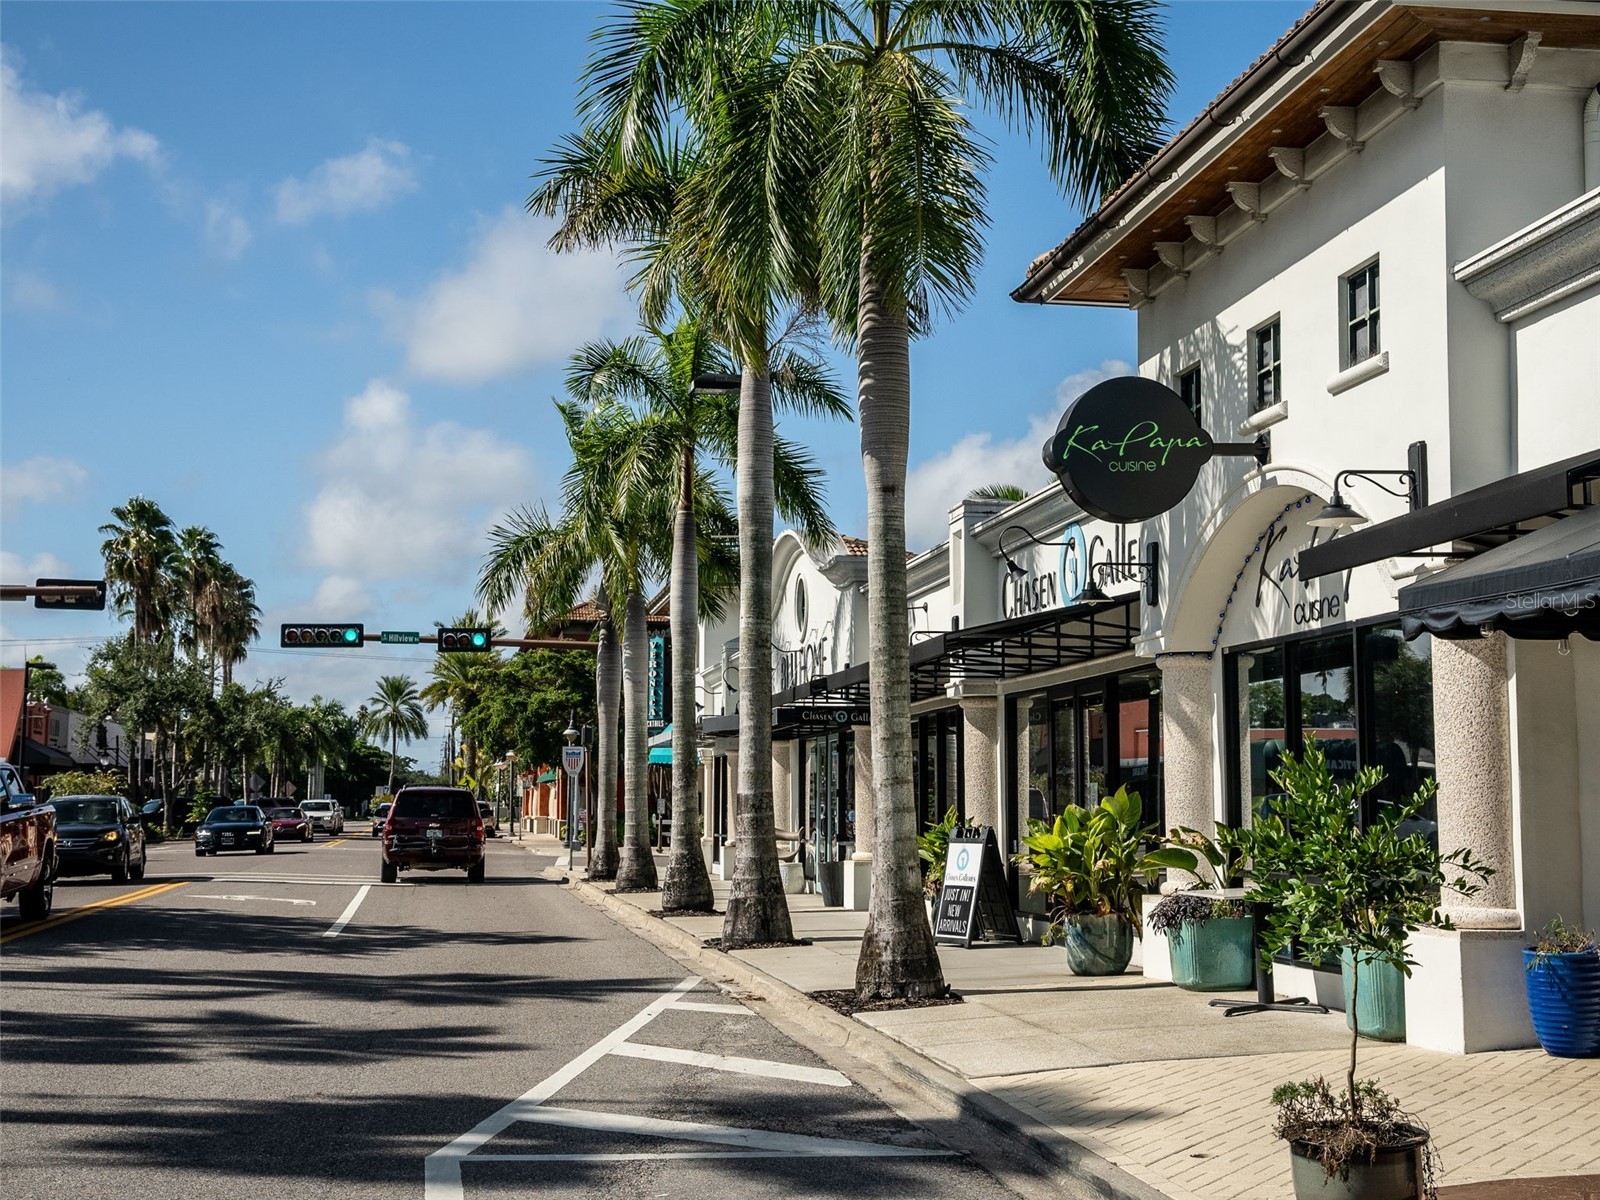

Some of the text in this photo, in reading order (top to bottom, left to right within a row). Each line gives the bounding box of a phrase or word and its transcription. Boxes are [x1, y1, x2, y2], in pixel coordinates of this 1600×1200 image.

[1088, 523, 1142, 590] GALLE
[388, 634, 414, 643] Hillview
[648, 641, 658, 716] VERONICA
[944, 888, 971, 902] JUST IN!
[947, 904, 962, 917] NEW
[939, 919, 968, 933] ARRIVALS
